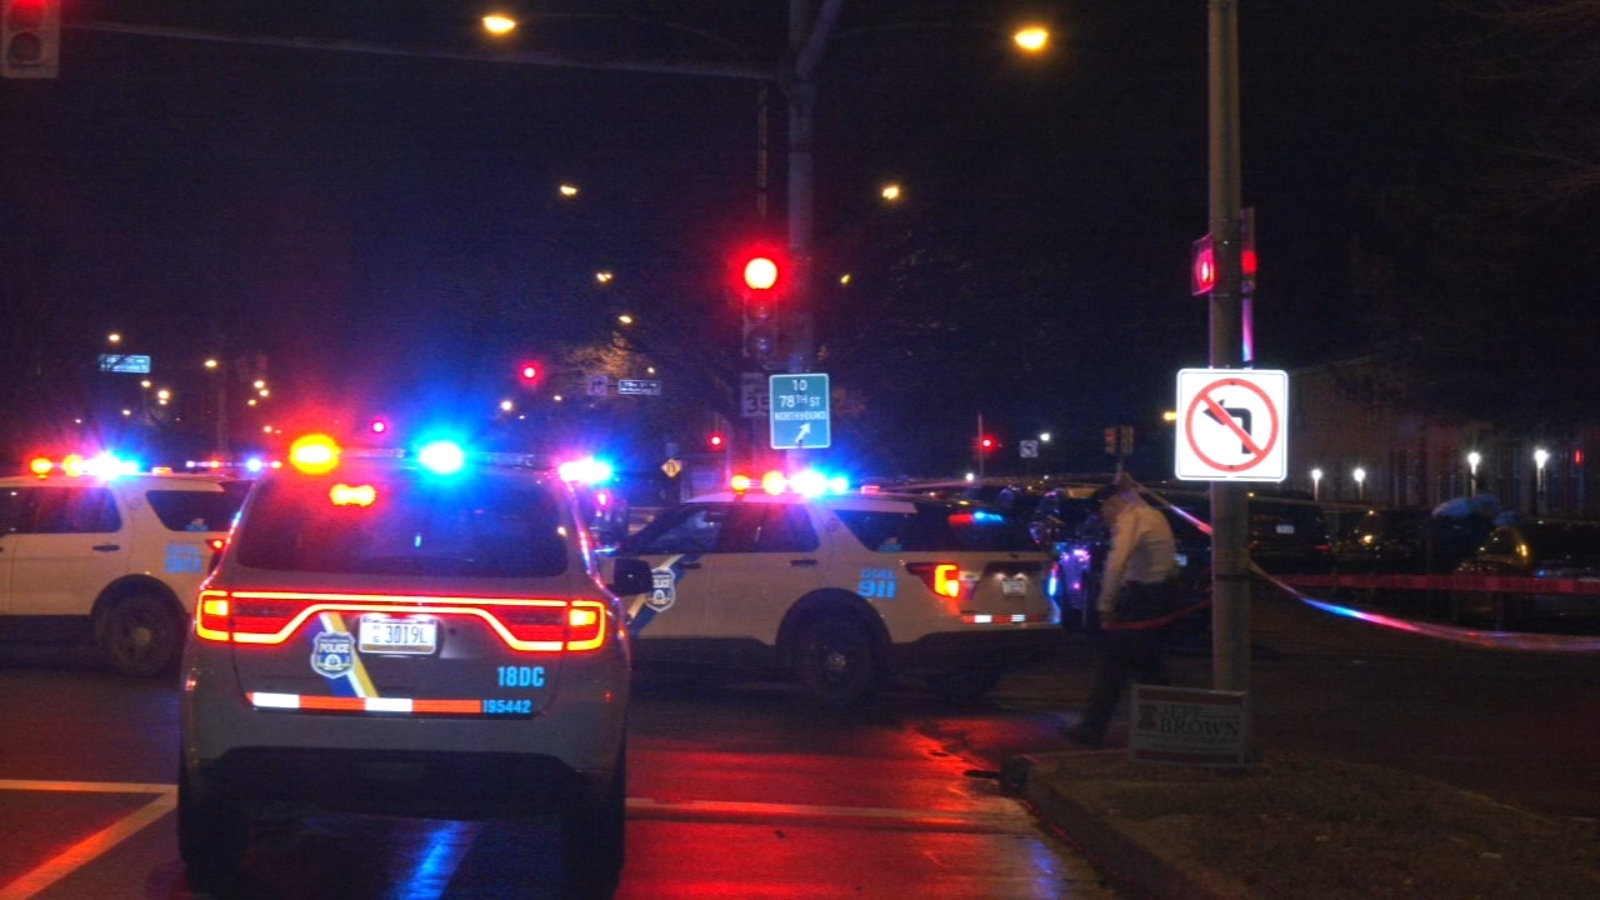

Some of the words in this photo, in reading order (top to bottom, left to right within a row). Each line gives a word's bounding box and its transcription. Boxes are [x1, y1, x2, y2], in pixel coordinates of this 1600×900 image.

[791, 379, 808, 391] 10
[809, 396, 821, 407] ST
[774, 410, 826, 421] NORTHBOUND
[857, 579, 897, 599] 911
[319, 642, 350, 653] POLICE
[497, 665, 545, 688] 18DC
[482, 698, 532, 714] 195442
[1160, 718, 1240, 736] BROWN
